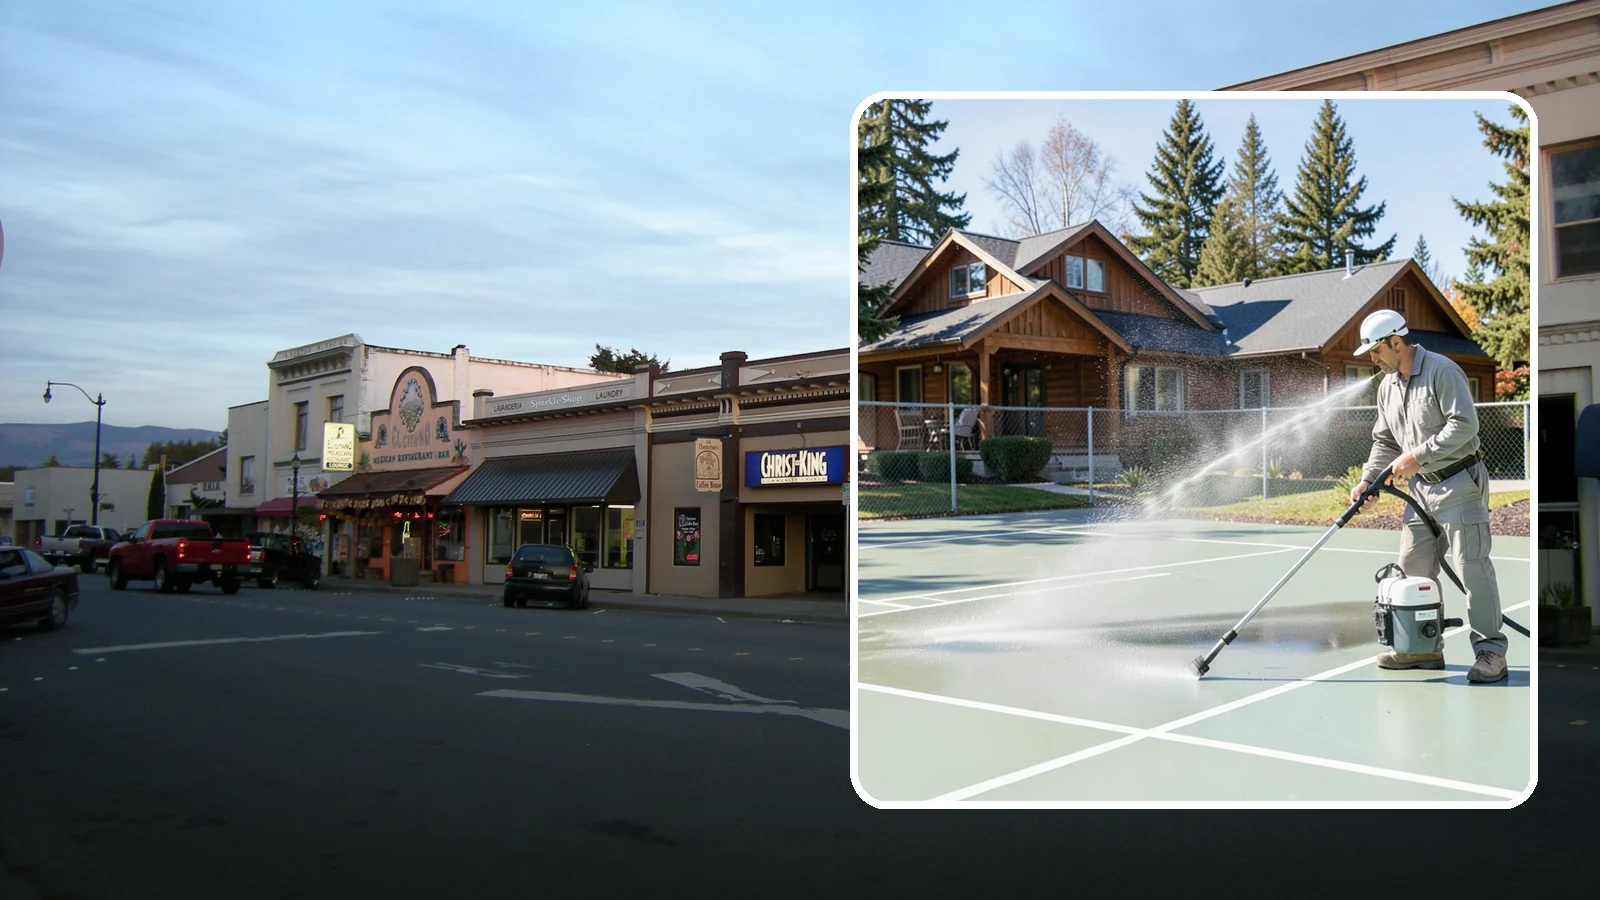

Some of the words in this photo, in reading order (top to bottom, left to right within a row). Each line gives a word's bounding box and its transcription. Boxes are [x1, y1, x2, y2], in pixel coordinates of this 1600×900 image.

[493, 402, 523, 413] LAVANDERIA
[562, 394, 583, 405] Shop
[595, 389, 623, 400] LAUNDRY
[392, 425, 401, 449] EL
[373, 455, 396, 464] MEXICAN
[397, 452, 433, 463] RESTAURANT
[438, 450, 450, 459] BAR
[760, 452, 797, 478] CHRIST
[799, 450, 827, 476] KING
[696, 481, 709, 489] Coffee
[710, 480, 722, 489] House
